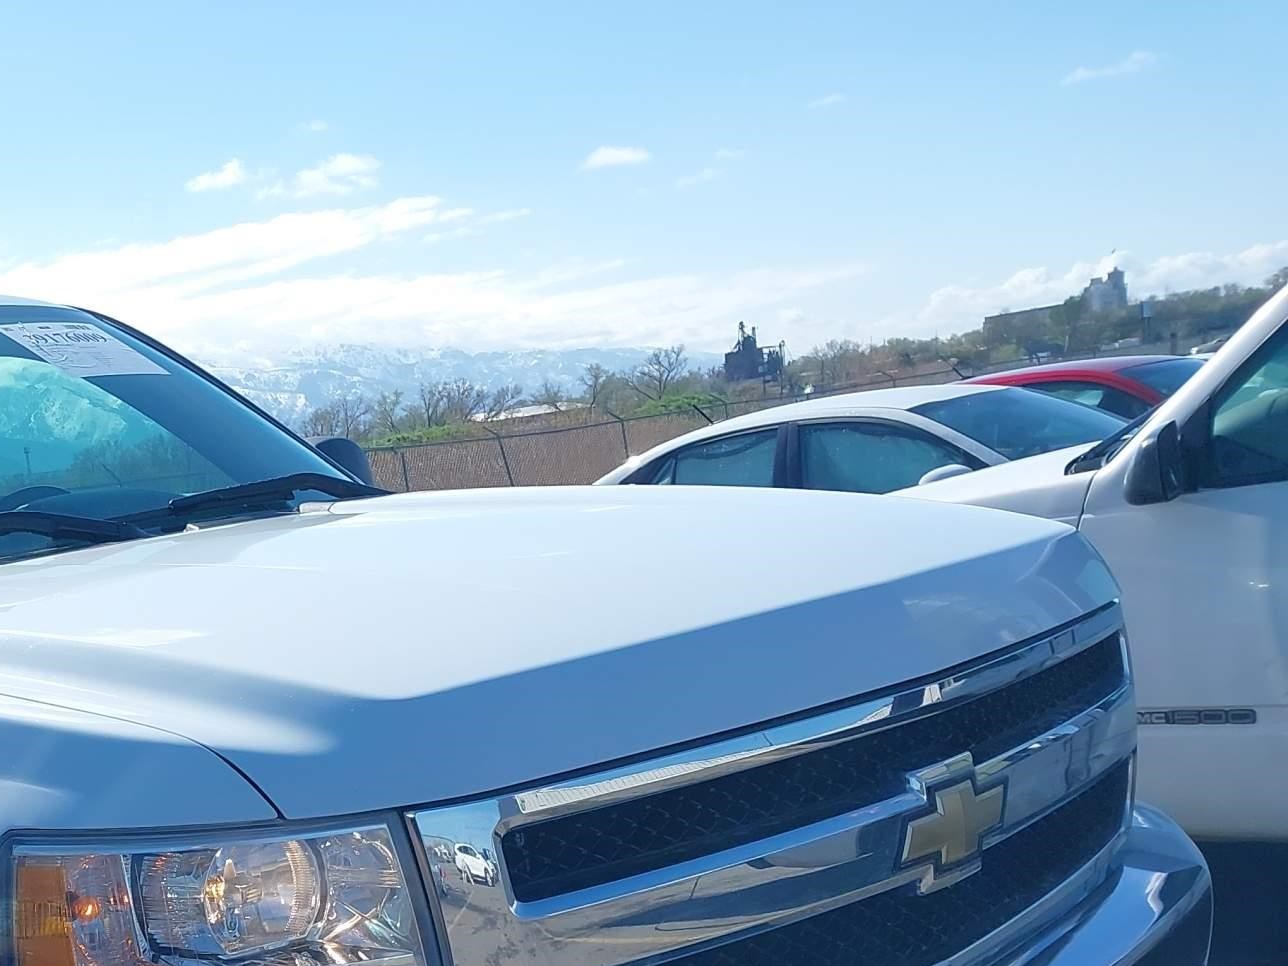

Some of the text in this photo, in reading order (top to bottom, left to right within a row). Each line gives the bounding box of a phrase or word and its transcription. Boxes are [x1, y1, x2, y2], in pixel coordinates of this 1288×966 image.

[22, 332, 108, 346] 39176009
[1137, 709, 1257, 725] MC 1500
